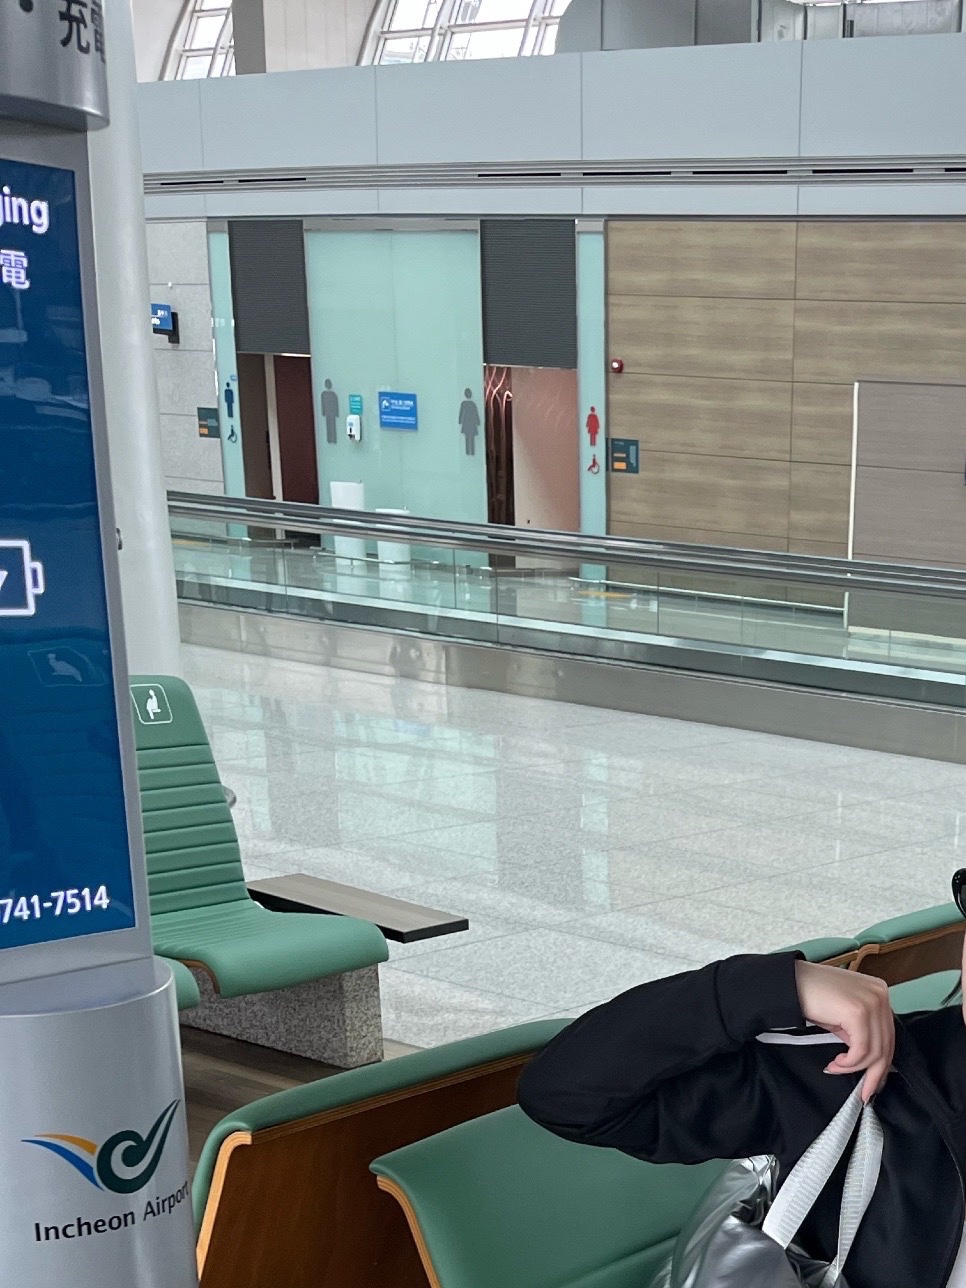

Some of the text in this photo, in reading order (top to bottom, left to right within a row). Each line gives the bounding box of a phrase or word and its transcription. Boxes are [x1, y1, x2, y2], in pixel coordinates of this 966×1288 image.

[0, 186, 49, 234] ing
[34, 1180, 190, 1242] Incheon Airport
